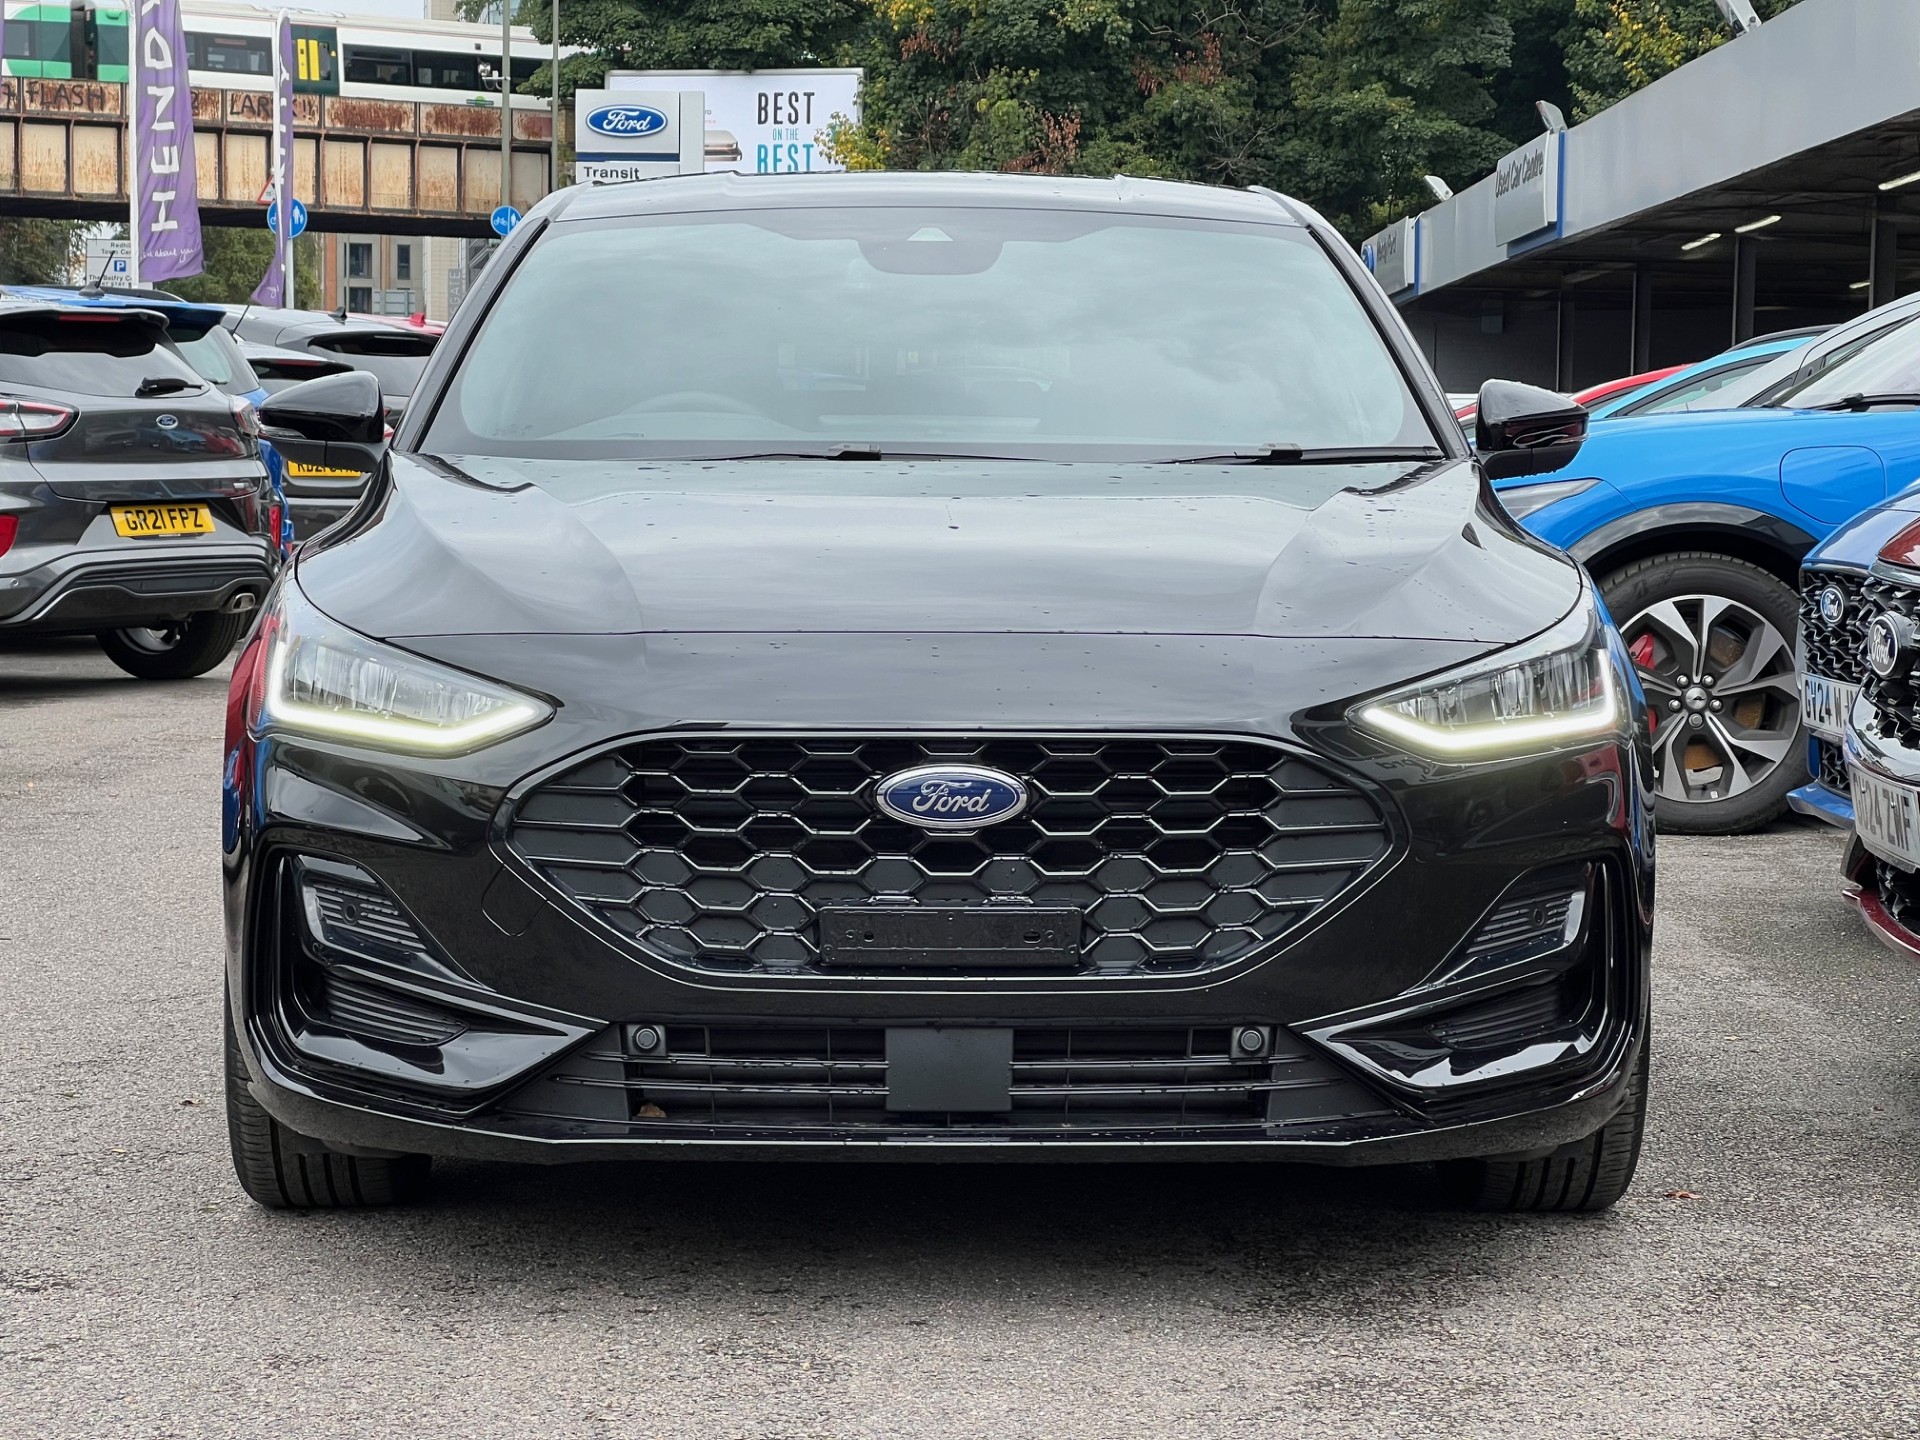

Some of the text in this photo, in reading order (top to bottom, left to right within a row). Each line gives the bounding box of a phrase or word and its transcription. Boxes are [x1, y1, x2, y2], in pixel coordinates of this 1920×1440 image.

[26, 80, 106, 112] FLASH
[757, 91, 815, 125] BEST
[603, 110, 651, 130] Ford
[772, 128, 799, 140] ON THE
[583, 166, 640, 180] Transit
[1495, 149, 1544, 198] Used Car Centre
[117, 261, 125, 271] P
[124, 507, 203, 530] GR21 FPZ
[1872, 624, 1891, 665] Ford
[912, 780, 992, 813] Ford
